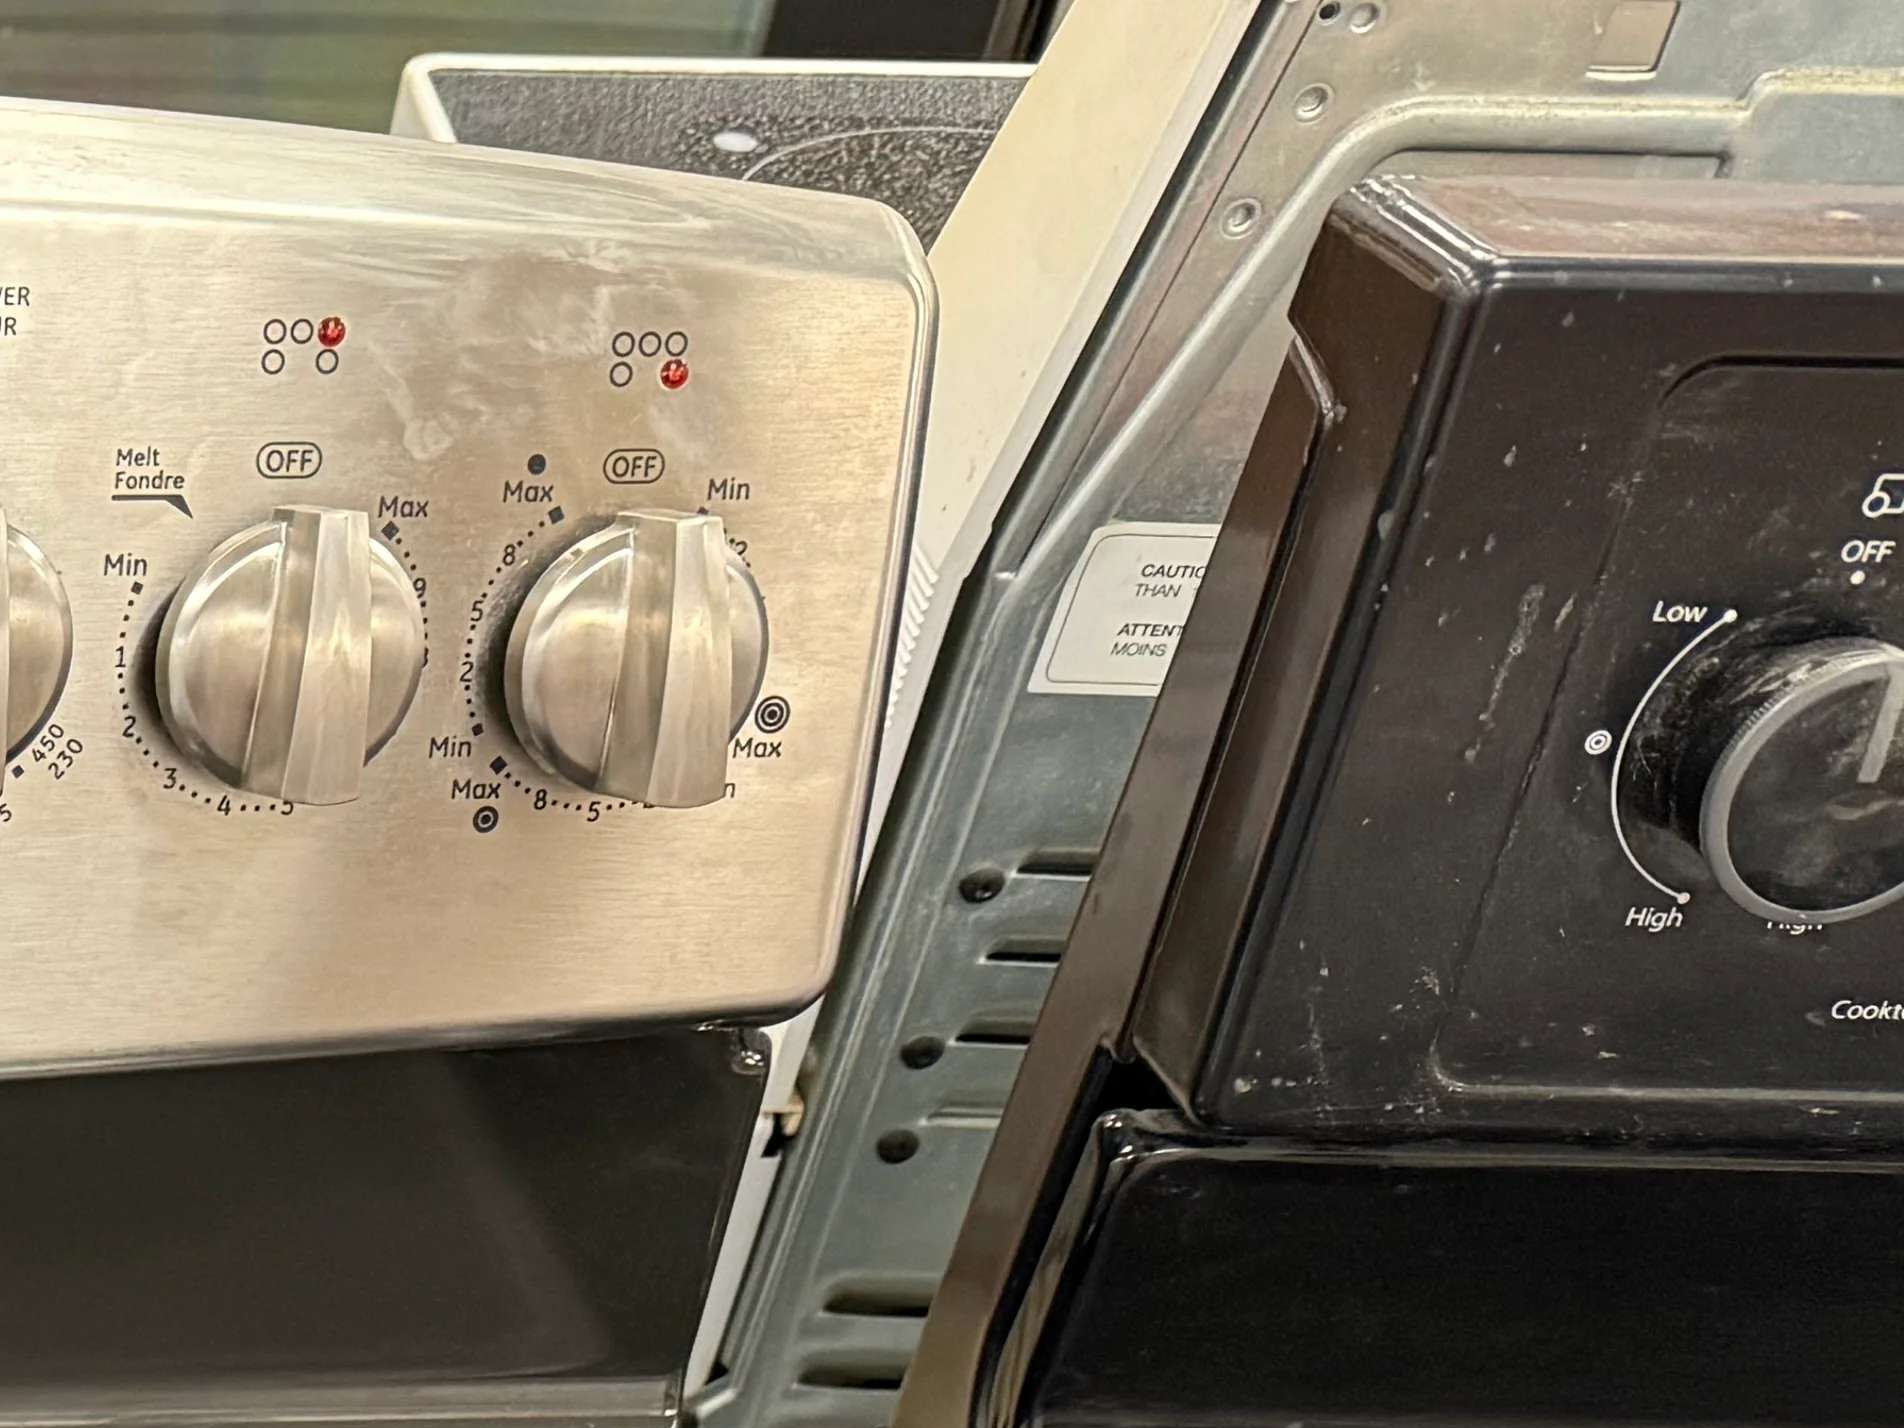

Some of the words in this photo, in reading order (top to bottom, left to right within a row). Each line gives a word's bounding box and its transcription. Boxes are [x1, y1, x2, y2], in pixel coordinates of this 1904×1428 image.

[115, 445, 160, 467] Melt
[265, 449, 314, 473] OFF
[611, 455, 658, 479] OFF
[114, 469, 186, 490] Fondre
[706, 476, 750, 501] Min
[502, 480, 554, 504] Max
[377, 495, 429, 519] Max
[502, 543, 516, 567] 8
[1840, 539, 1896, 563] OFF
[103, 552, 148, 577] Min
[1136, 584, 1181, 597] THAN
[469, 599, 484, 623] 5
[1111, 643, 1167, 656] MOINS
[459, 660, 474, 683] 2
[122, 715, 137, 738] 2
[428, 735, 472, 759] Min
[732, 737, 782, 759] Max
[163, 767, 178, 790] 3
[451, 778, 502, 800] Max
[216, 794, 231, 817] 4
[533, 788, 548, 811] 8
[586, 800, 602, 823] 5
[1624, 906, 1683, 933] High
